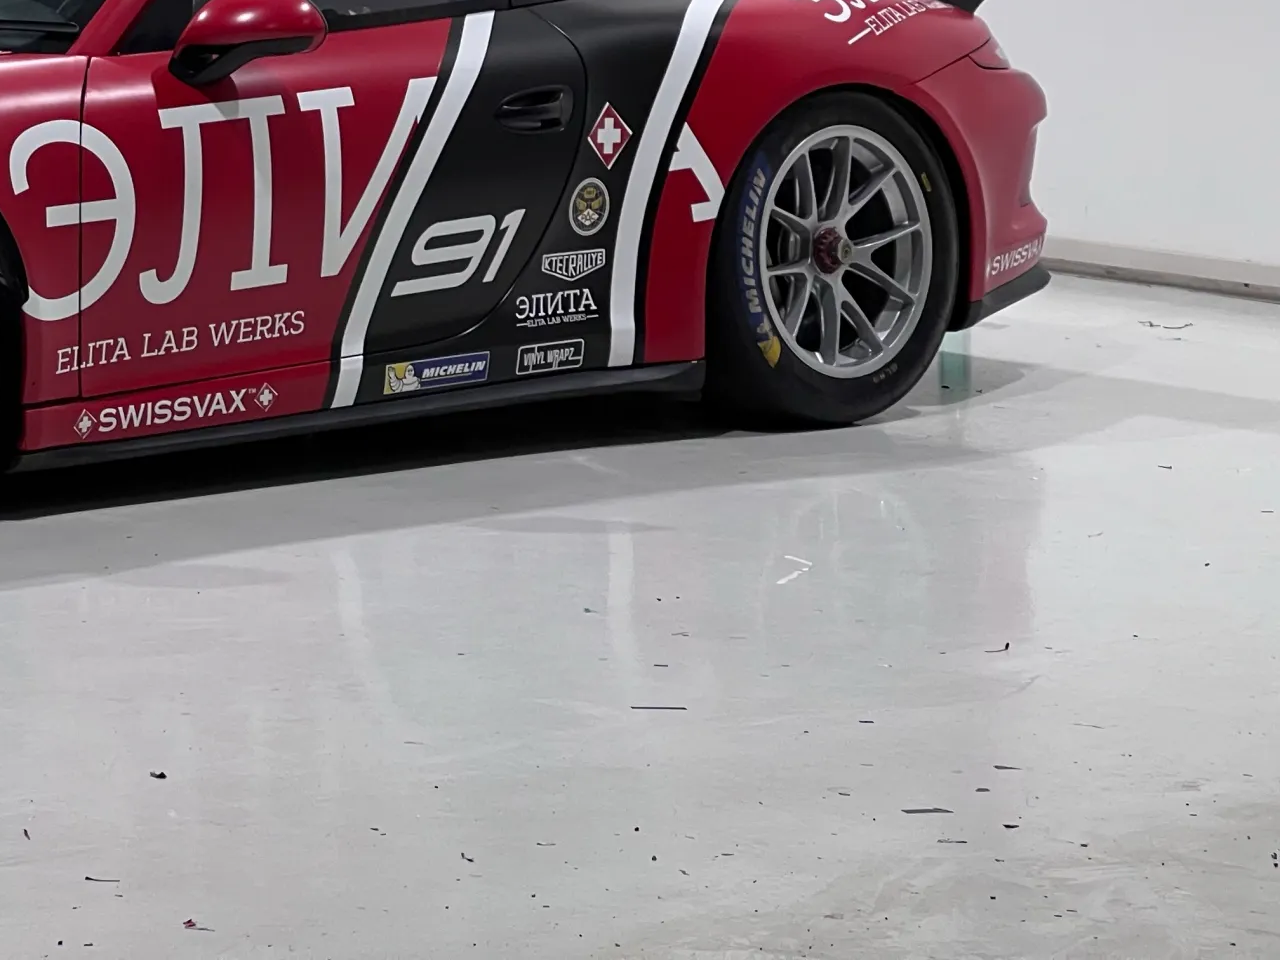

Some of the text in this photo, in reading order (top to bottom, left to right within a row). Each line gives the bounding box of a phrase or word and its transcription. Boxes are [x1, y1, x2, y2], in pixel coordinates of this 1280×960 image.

[391, 209, 526, 297] 91
[741, 167, 767, 313] MICHELIN
[515, 288, 598, 319] ЭЛИТА
[55, 310, 305, 374] ELITA LAB WERKS
[523, 347, 575, 368] VINYL WRAPZ
[422, 360, 486, 379] MICHELIN
[98, 388, 248, 432] SWISSVAX
